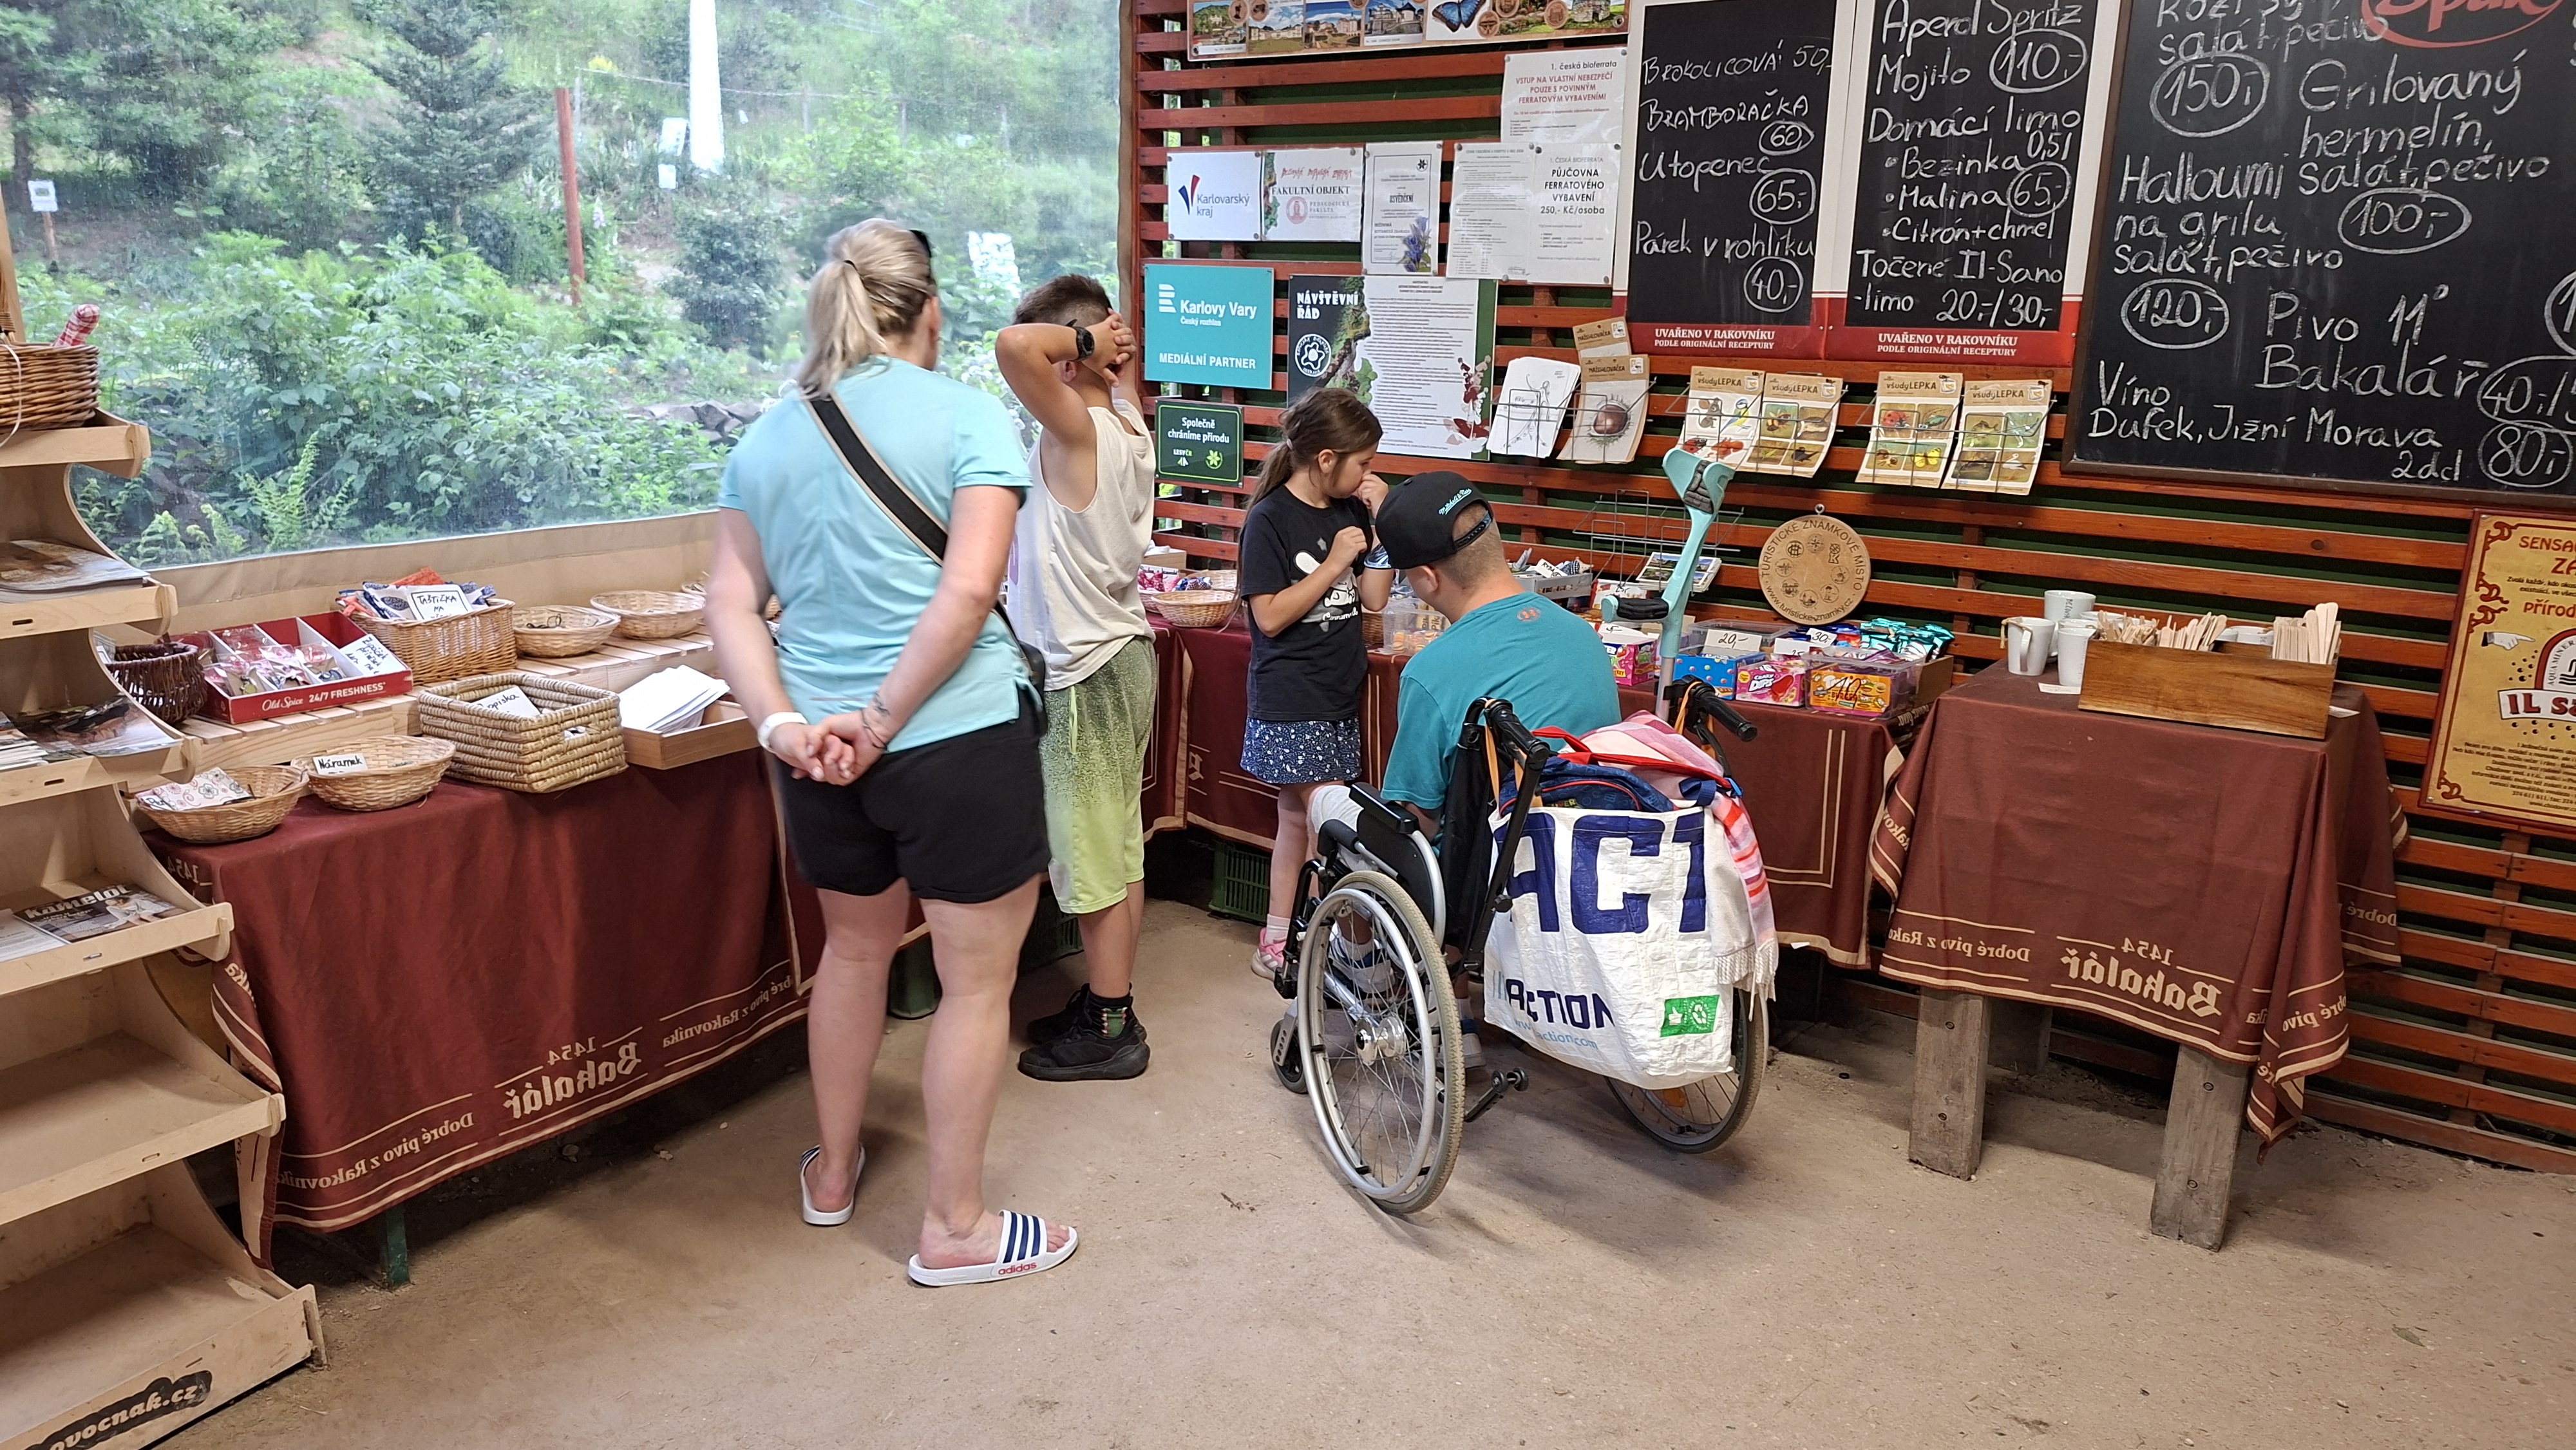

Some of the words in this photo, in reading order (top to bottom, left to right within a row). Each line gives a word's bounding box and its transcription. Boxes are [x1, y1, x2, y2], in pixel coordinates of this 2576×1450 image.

[1560, 62, 1580, 70] česká
[1583, 61, 1617, 69] bioferrata
[1549, 73, 1576, 82] VLASTNÍ
[1578, 71, 1613, 81] NEBEZPEČÍ
[1876, 47, 1971, 101] Mojito
[2299, 48, 2528, 115] Grilovaný
[1519, 94, 1562, 104] FERRATOVÝM
[1565, 93, 1606, 102] VYBAVENÍM!
[1640, 89, 1808, 131] BRAMBORAČKA
[1868, 106, 1994, 143] Domácí
[2004, 96, 2081, 133] limo
[1900, 137, 2022, 180] Bezinka
[1552, 167, 1599, 177] PŮJČOVNA
[1639, 151, 1772, 193] Utopenec
[2117, 151, 2289, 205] Halloumi
[1272, 184, 1314, 195] FAKULTNÍ
[1316, 186, 1350, 195] OBJEKT
[1544, 180, 1604, 189] FERRATOVÉHO
[1197, 193, 1249, 206] Karlovarský
[1552, 191, 1595, 202] VYBAVENÍ
[1899, 182, 2007, 211] Malina
[1197, 207, 1213, 218] kraj
[1564, 205, 1605, 214] Kč/osoba
[2114, 212, 2161, 241] na
[1636, 218, 1692, 254] Párek
[1705, 237, 1719, 255] v
[1724, 223, 1815, 263] rohlíku
[1857, 249, 1951, 278] Točené
[1297, 290, 1359, 306] NÁVŠTĚVNÍ
[1180, 300, 1226, 315] Karlovy
[1229, 302, 1257, 319] Vary
[1297, 306, 1320, 319] ŘÁD
[2266, 287, 2360, 341] Pivo
[1180, 315, 1198, 326] Český
[1655, 327, 1702, 338] UVAŘENO
[1705, 330, 1712, 338] V
[1714, 329, 1775, 339] RAKOVNÍKU
[1879, 332, 1933, 344] UVAŘENO
[1935, 335, 1944, 344] V
[1946, 334, 2018, 346] RAKOVNÍKU
[1680, 339, 1727, 348] ORIGINÁLNÍ
[1908, 345, 1961, 355] ORIGINÁLNÍ
[1963, 347, 2017, 356] RECEPTURY
[1159, 351, 1206, 366] MEDIÁLNÍ
[1209, 356, 1256, 370] PARTNER
[2254, 339, 2490, 399] Bakalář
[1697, 376, 1741, 386] všudyLEPKA
[1772, 383, 1818, 393] všudyLEPKA
[1886, 381, 1937, 390] všudyLEPKA
[2098, 360, 2171, 407] Víno
[1973, 389, 2024, 399] všudyLEPKA
[1182, 417, 1215, 429] Společně
[2304, 407, 2443, 449] Morava
[1168, 429, 1201, 441] chráníme
[1202, 430, 1229, 444] přírodu
[2519, 536, 2576, 552] SENSA
[1761, 522, 1799, 578] TURISTICKÉ
[1803, 519, 1860, 553] ZNÁMKOVÉ
[1853, 555, 1866, 590] MÍSTO
[1748, 678, 1774, 692] DIPS
[261, 699, 279, 711] Old
[281, 696, 303, 708] Spice
[309, 692, 328, 702] 24/7
[319, 756, 363, 769] Náramek
[24, 884, 131, 919] Kamelot
[998, 1262, 1037, 1276] adidas
